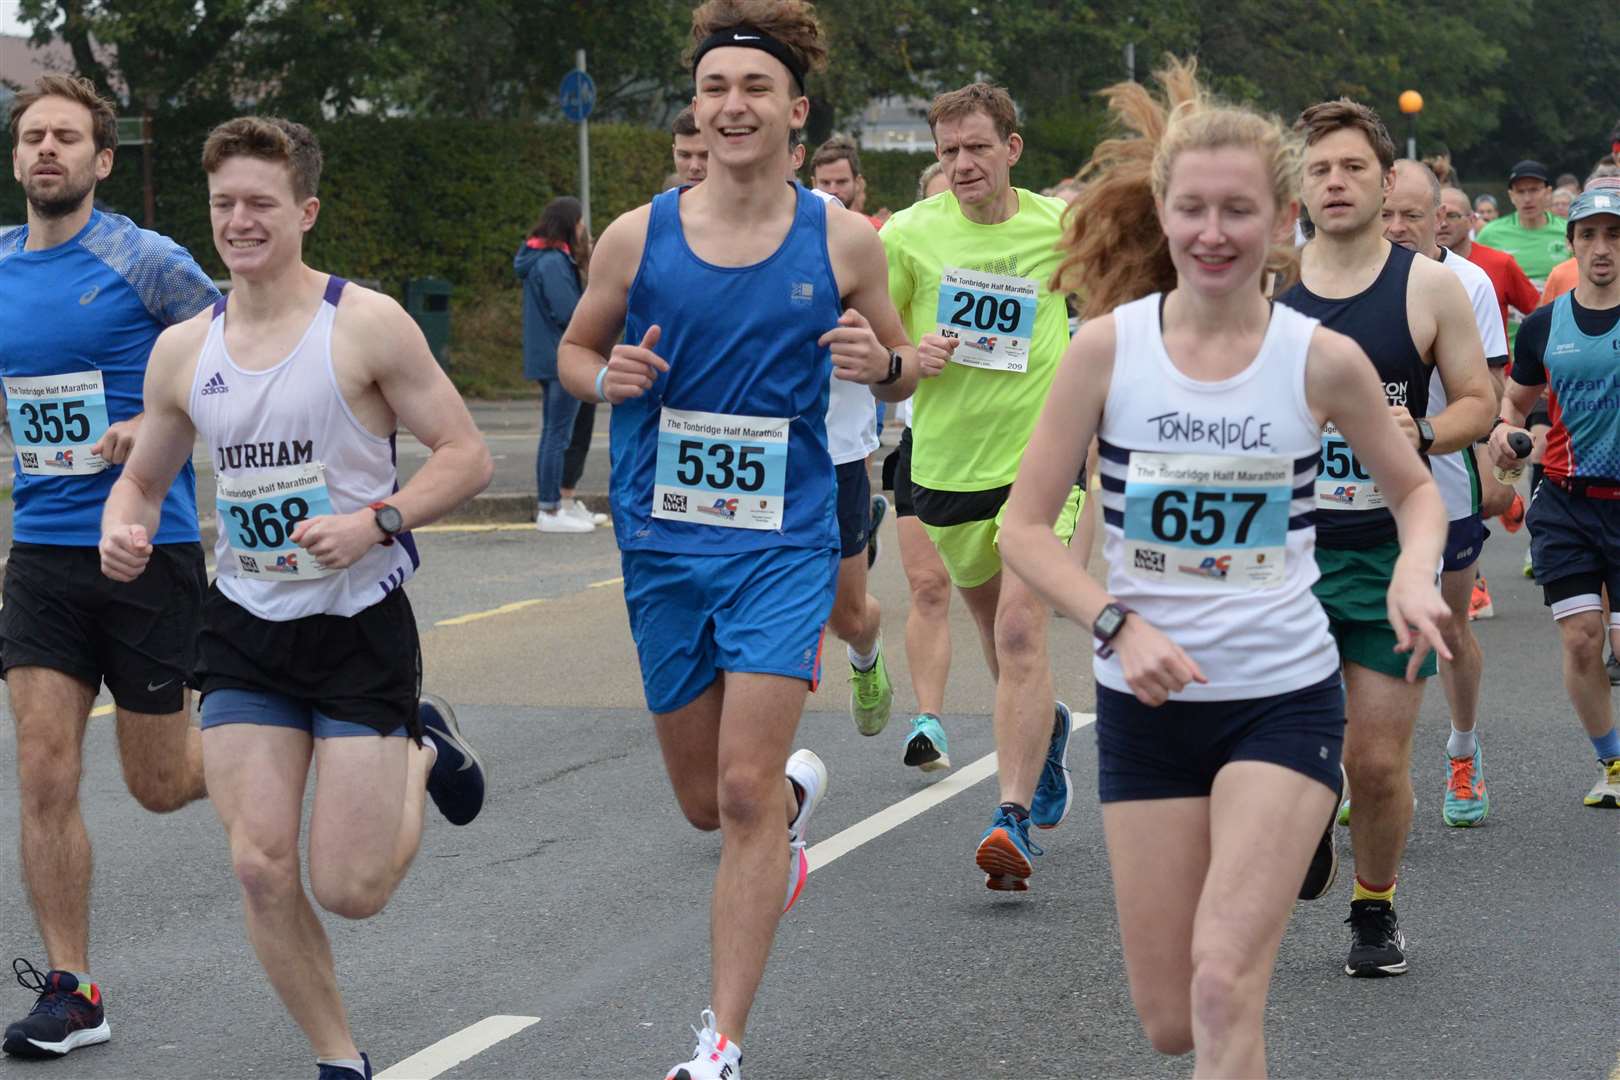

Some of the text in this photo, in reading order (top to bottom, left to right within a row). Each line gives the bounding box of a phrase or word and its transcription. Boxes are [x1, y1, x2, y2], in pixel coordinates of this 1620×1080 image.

[946, 275, 1034, 295] The Tonbridge Half Marathon
[950, 291, 1021, 334] 209
[1007, 362, 1023, 370] 209
[46, 386, 59, 395] Half
[61, 383, 98, 393] Marathon
[201, 386, 229, 396] adidas
[20, 400, 91, 443] 355
[666, 419, 783, 438] The Tonbridge Half Marathon
[1147, 412, 1271, 450] TONBRIDGE
[677, 440, 765, 492] 535
[1137, 467, 1286, 482] The Tonbridge Half Marathon
[258, 484, 276, 495] Half
[277, 475, 319, 491] Marathon
[230, 497, 309, 548] 368
[1152, 490, 1267, 545] 657
